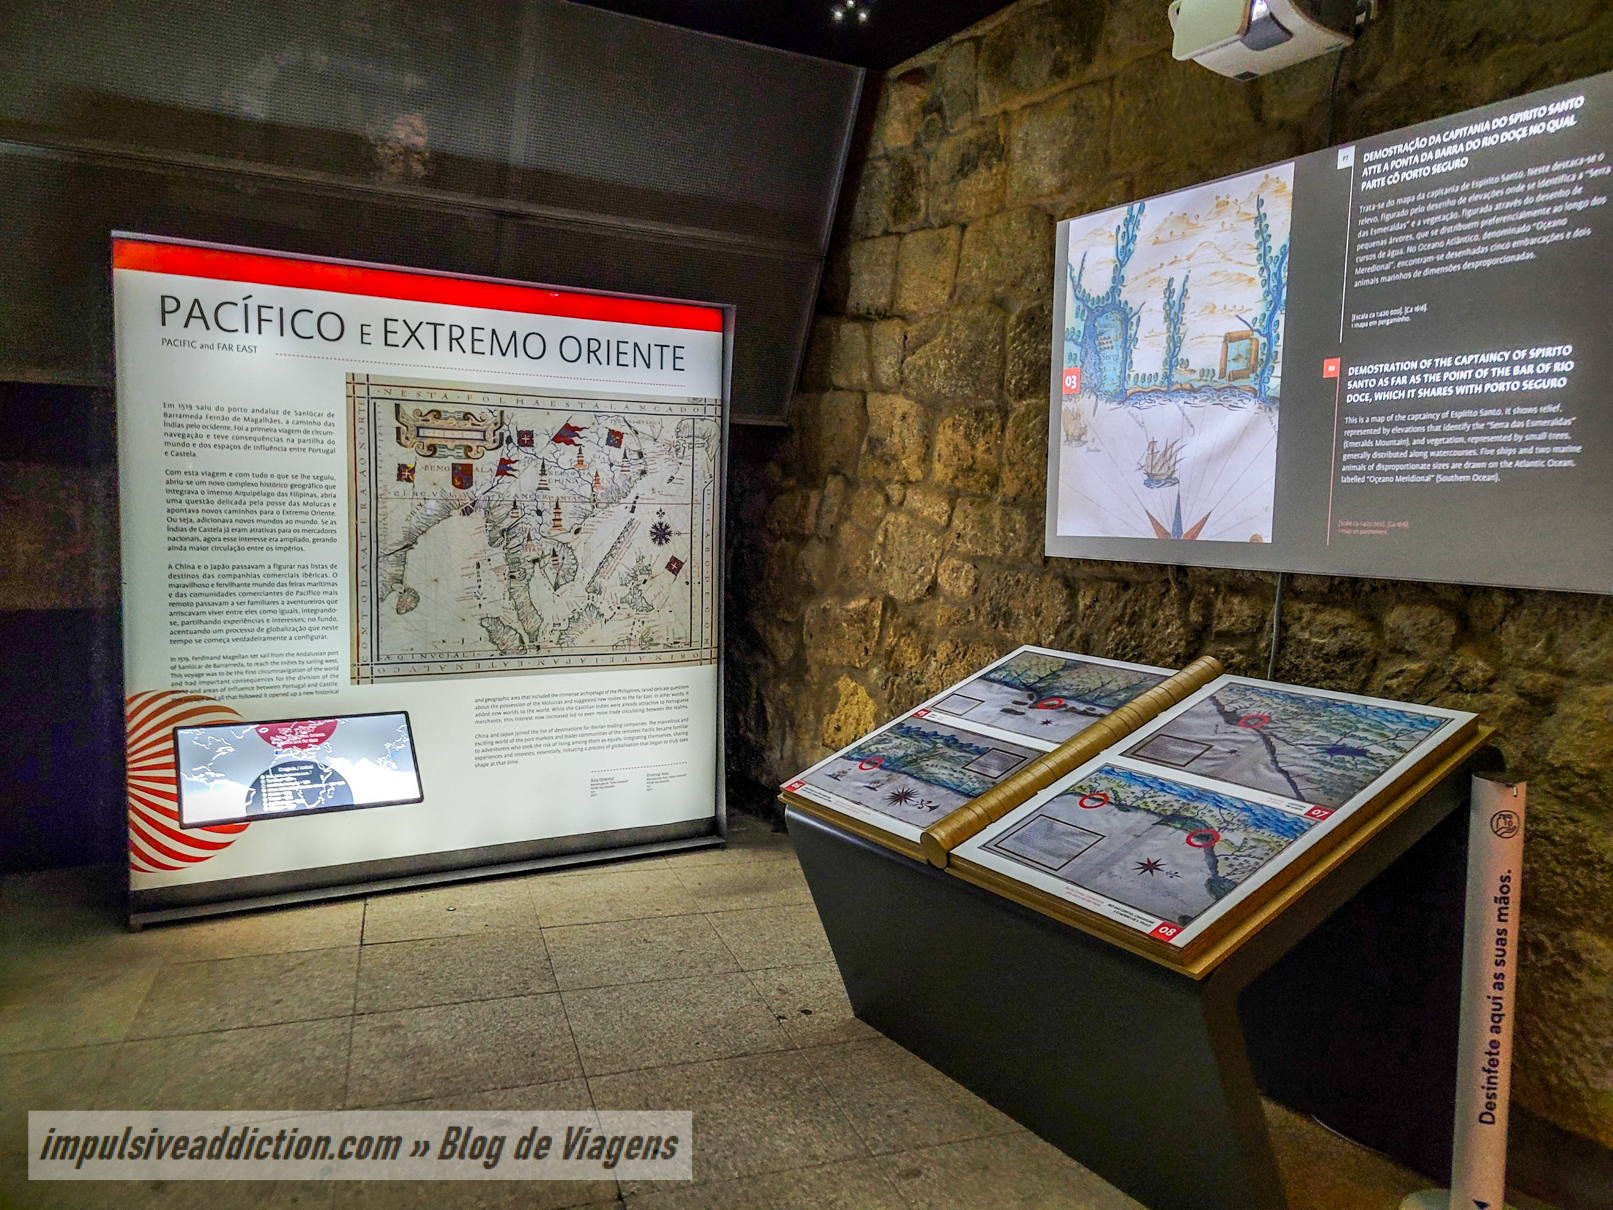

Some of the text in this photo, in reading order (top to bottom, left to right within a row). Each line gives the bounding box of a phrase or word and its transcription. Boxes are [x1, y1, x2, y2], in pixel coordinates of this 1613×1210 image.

[1363, 96, 1585, 163] DEMOSTRAÇÃO DA CAPITANIA DO SPIRITO SANTO
[1362, 115, 1577, 177] ATTE A PONTA DA BARRA DO RIO DOÇE NO QUAL
[1361, 177, 1386, 191] PARTE
[1401, 166, 1430, 183] PORTO
[1431, 157, 1468, 175] SEGURO
[161, 294, 685, 372] PACÍFICO E EXTREMO ORIENTE
[161, 338, 258, 354] PACIFIC and FAR EAST
[1348, 345, 1572, 376] DEMOSTRATION OF THE CAPTAINCY OF SPIRITO
[1065, 375, 1077, 389] 03
[1347, 361, 1575, 389] SANTO AS FAR AS THE POINT OF THE BAR OF RIO
[1346, 377, 1567, 404] DOCE, WHICH IT SHARES WITH PORTO SEGURO
[163, 412, 202, 420] Barrameda
[227, 406, 247, 415] porto
[1344, 415, 1358, 424] This
[1358, 415, 1364, 423] is
[1370, 416, 1385, 425] map
[1386, 413, 1394, 422] of
[1394, 413, 1406, 421] the
[1406, 411, 1440, 423] captaincy
[1440, 410, 1449, 419] of
[1512, 406, 1538, 415] shows
[163, 420, 184, 429] Índias
[185, 423, 200, 431] pelo
[250, 426, 276, 434] primeira
[278, 427, 301, 436] viagem
[164, 431, 203, 440] navegação
[231, 434, 282, 444] consequências
[297, 437, 323, 446] partilha
[308, 446, 335, 455] Portugal
[1341, 463, 1366, 472] animals
[1367, 463, 1374, 471] of
[1375, 462, 1431, 473] disproportionate
[1431, 461, 1450, 470] sizes
[1499, 460, 1513, 468] the
[1340, 475, 1365, 483] labelled
[1311, 809, 1329, 818] 07
[1158, 926, 1177, 937] 08
[1478, 869, 1512, 1126] Desinfete aqui as suas mãos.
